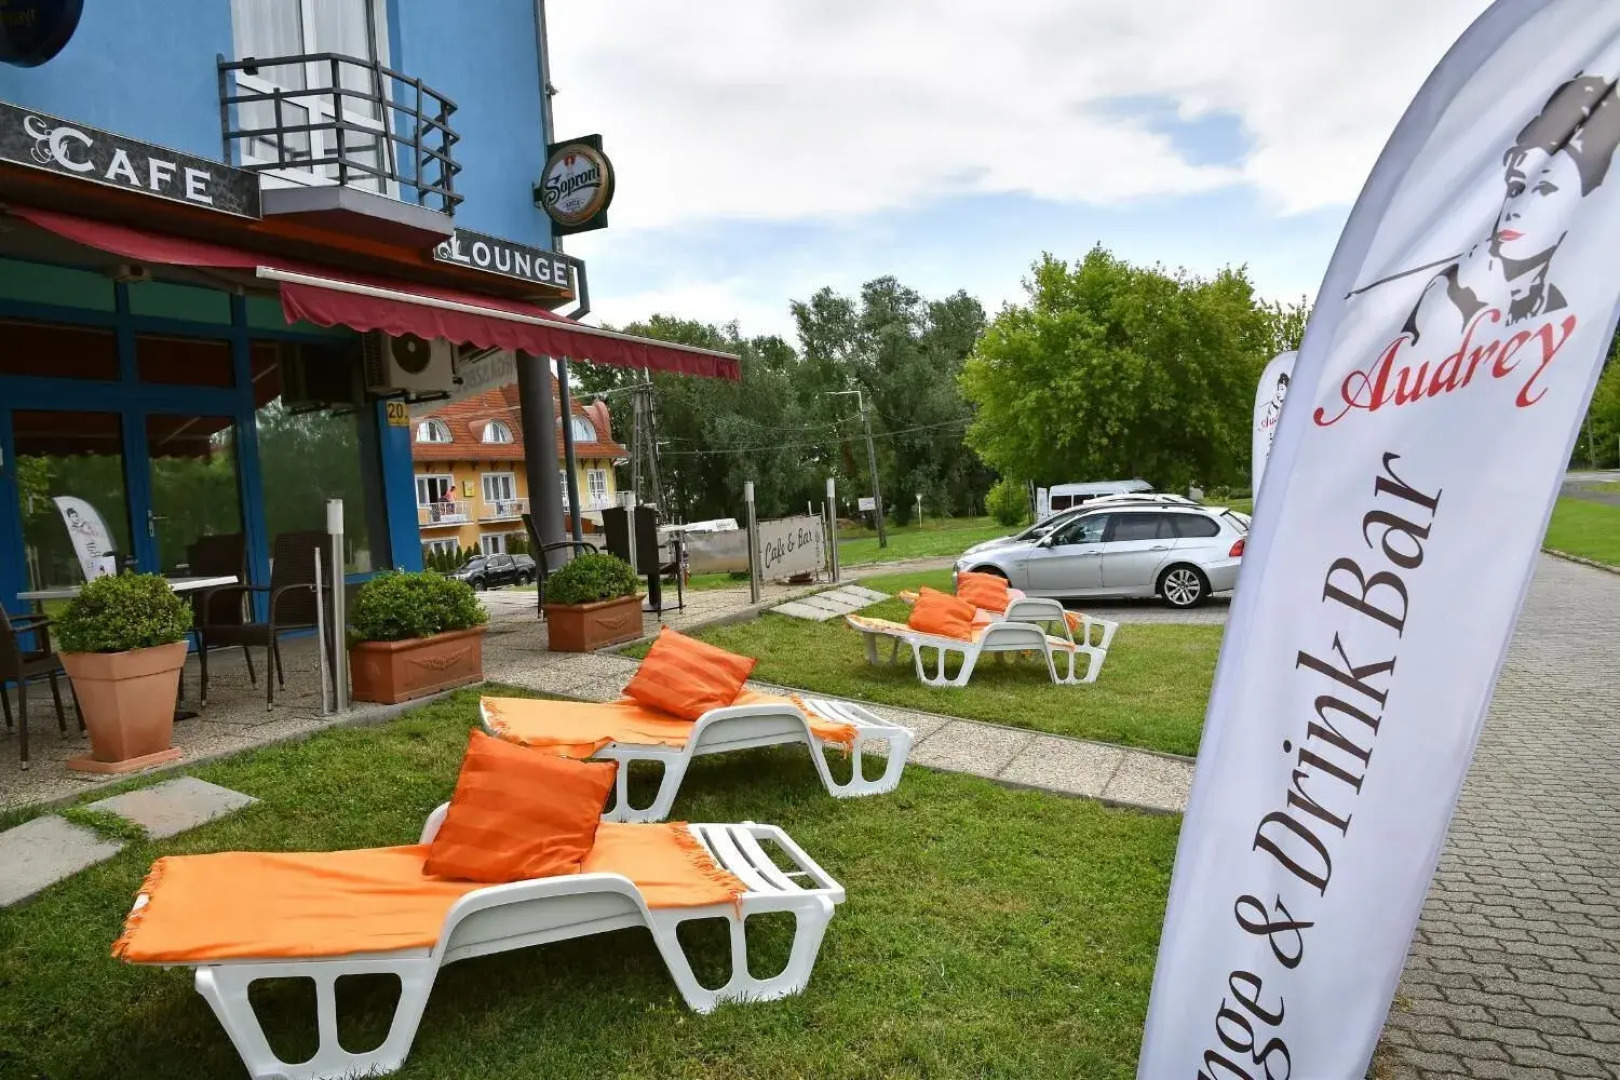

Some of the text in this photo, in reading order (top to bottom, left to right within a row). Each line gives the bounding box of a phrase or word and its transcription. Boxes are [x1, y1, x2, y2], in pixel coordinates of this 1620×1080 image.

[48, 125, 214, 206] CAFE
[544, 163, 601, 206] Soproni
[449, 229, 568, 286] LOUNGE
[1313, 308, 1577, 427] Audrey
[787, 532, 795, 553] &
[798, 527, 813, 549] Bar
[1322, 451, 1443, 639] Bar
[1252, 631, 1397, 898] Drink
[1233, 893, 1316, 970] &
